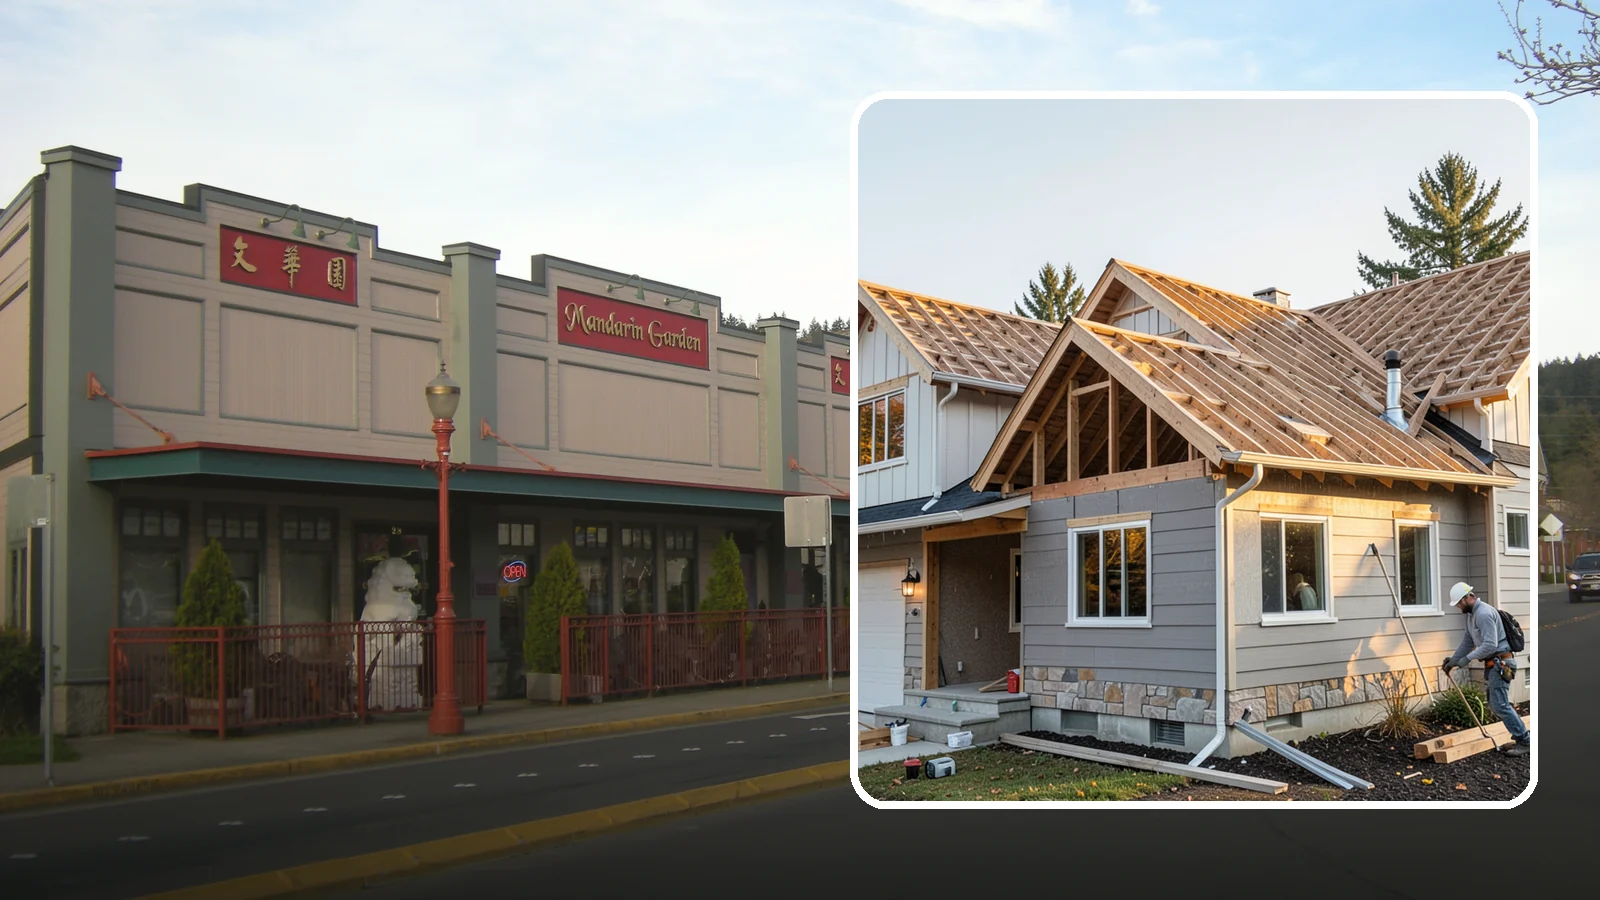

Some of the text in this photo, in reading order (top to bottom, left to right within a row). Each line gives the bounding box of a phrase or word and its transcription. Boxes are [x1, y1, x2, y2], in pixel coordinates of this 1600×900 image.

[231, 235, 346, 291] 文華園
[564, 302, 702, 352] Mandarin Garden
[835, 363, 846, 386] 文
[503, 565, 527, 578] OPEN
